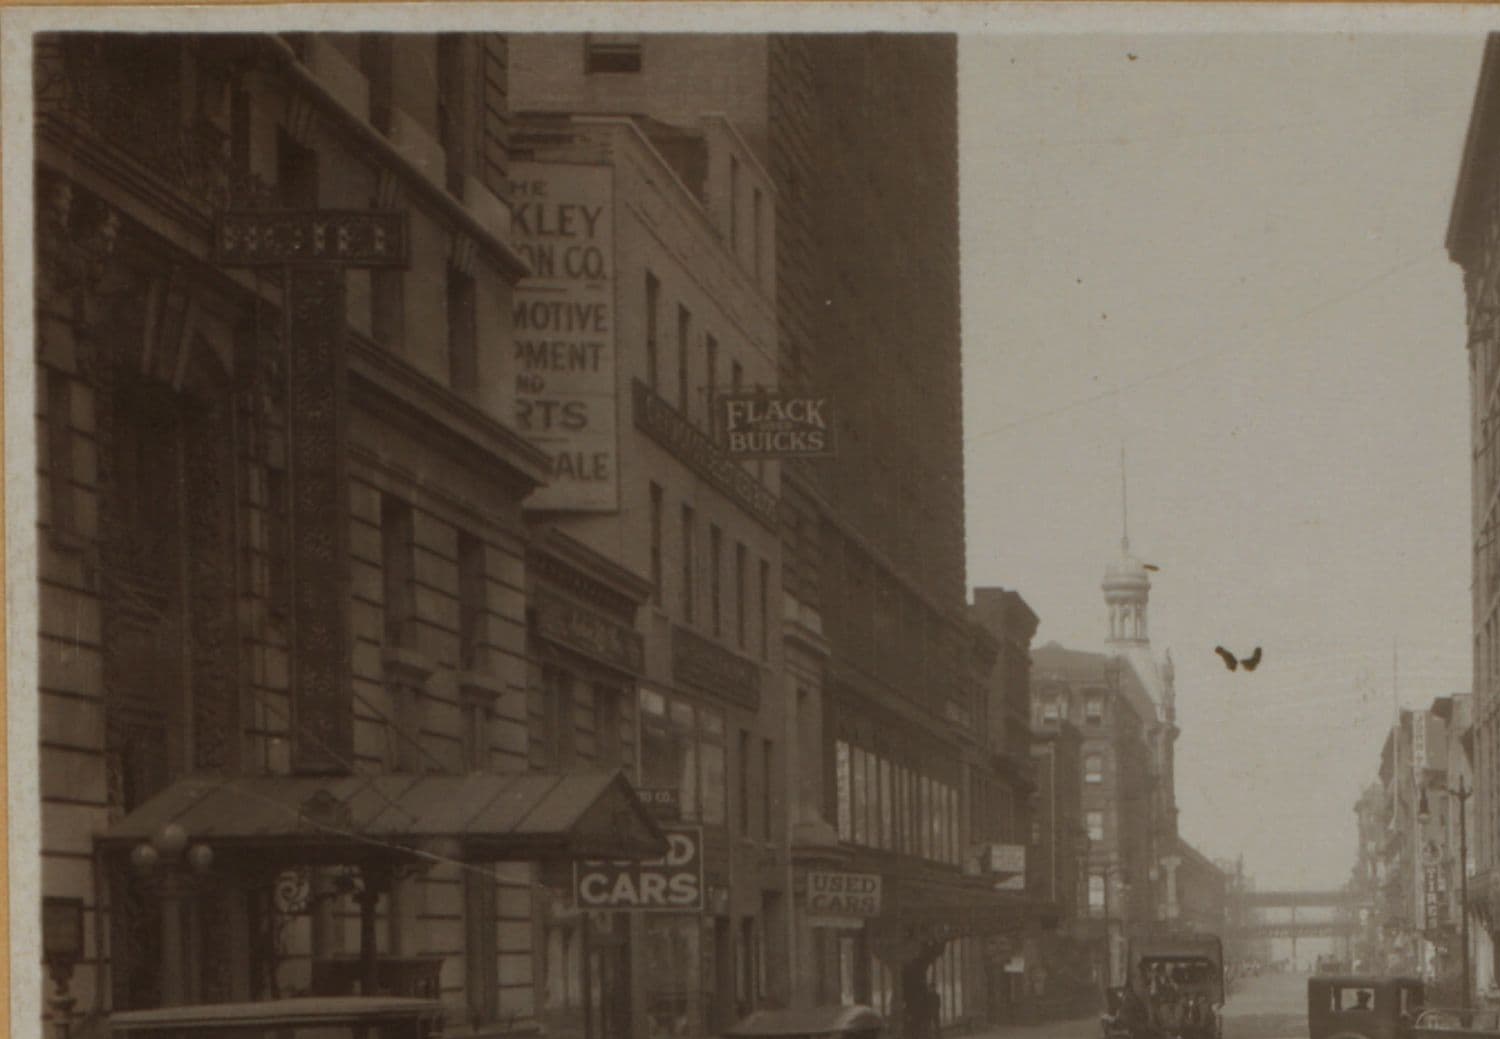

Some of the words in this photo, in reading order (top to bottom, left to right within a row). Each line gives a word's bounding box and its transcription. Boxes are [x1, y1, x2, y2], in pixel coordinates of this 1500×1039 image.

[727, 399, 827, 432] FLACK
[729, 431, 825, 452] BUICKS
[580, 872, 699, 905] CARS
